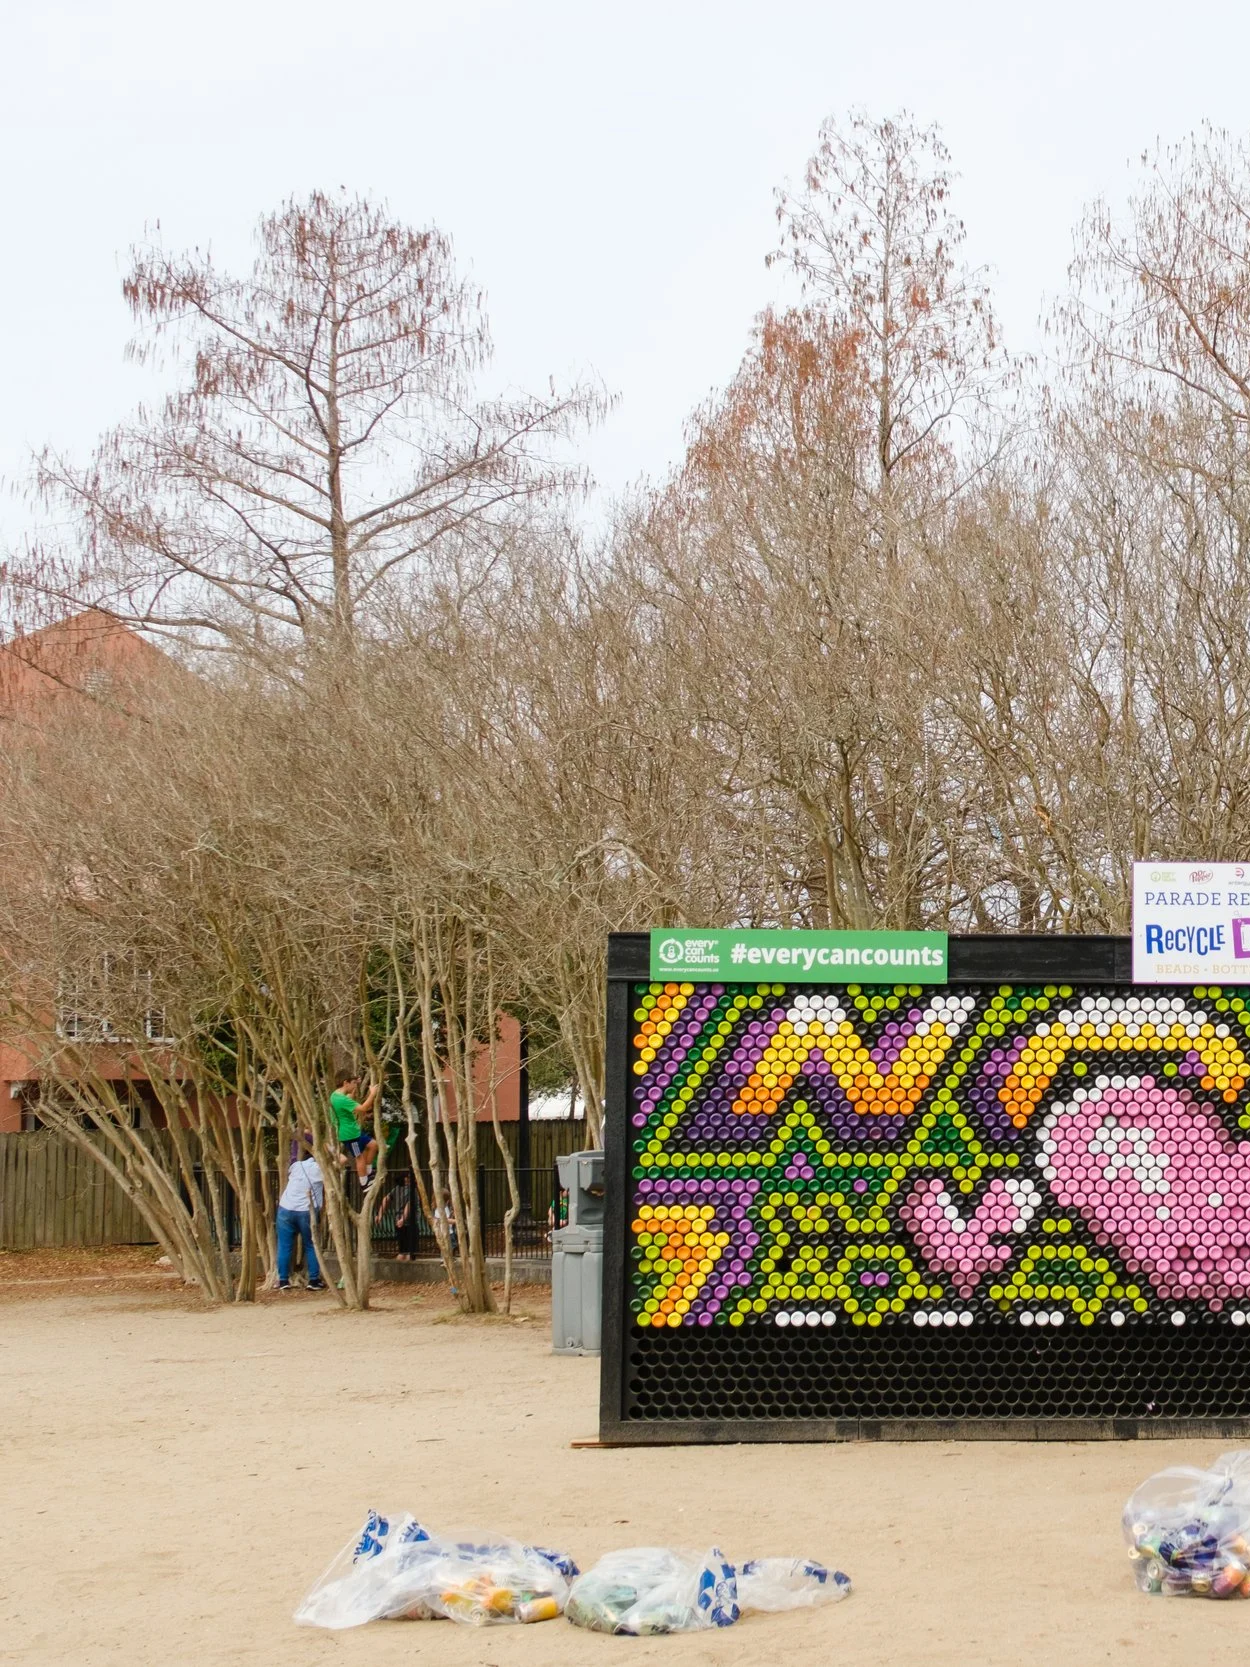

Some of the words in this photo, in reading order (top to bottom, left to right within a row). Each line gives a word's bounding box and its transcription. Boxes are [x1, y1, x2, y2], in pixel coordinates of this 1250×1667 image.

[1145, 892, 1221, 906] PARADE
[685, 947, 704, 955] can
[685, 954, 720, 964] counts
[730, 943, 944, 971] #everycancounts
[1156, 964, 1200, 975] BEADS
